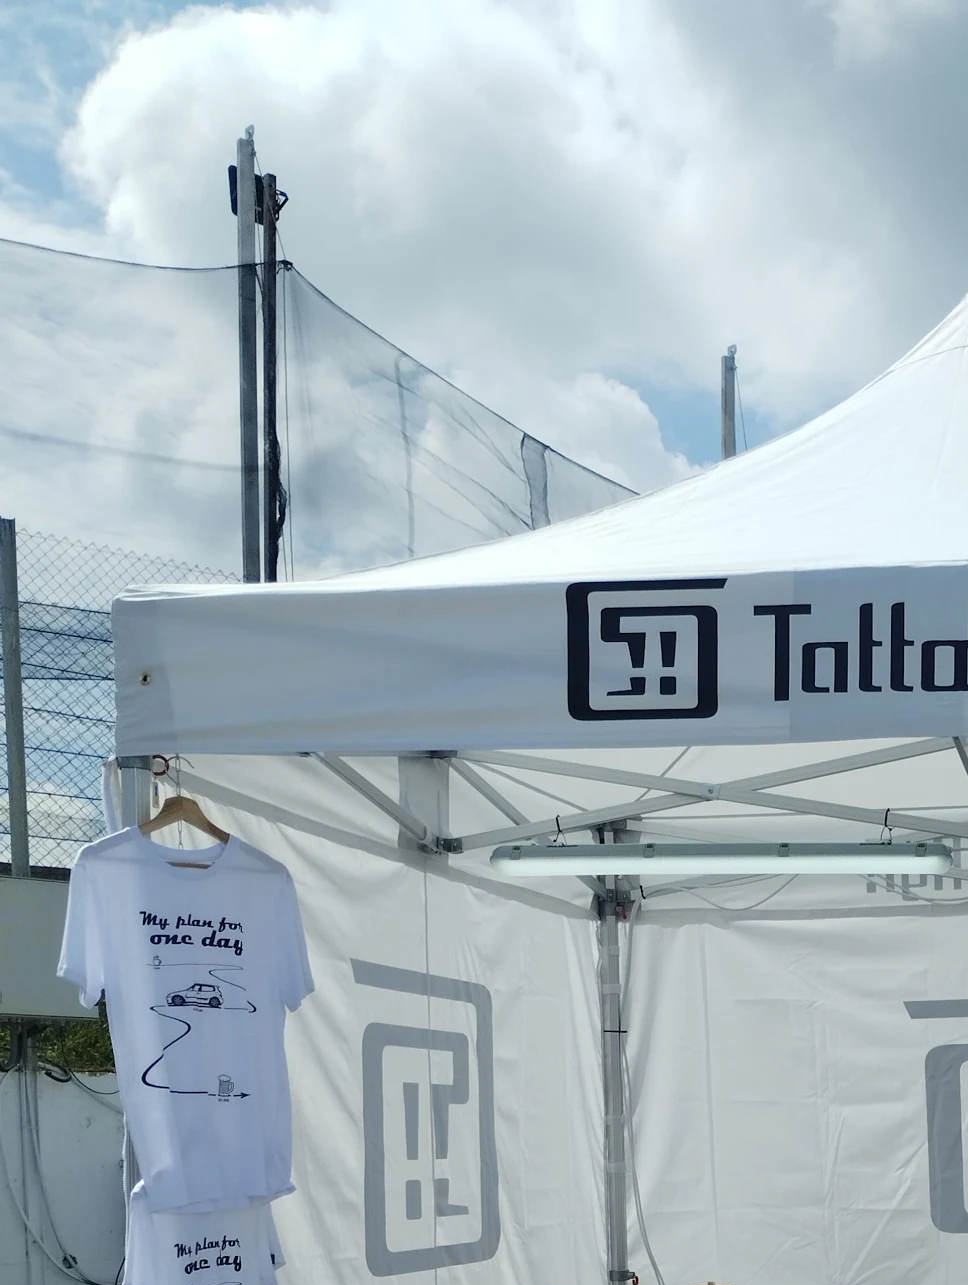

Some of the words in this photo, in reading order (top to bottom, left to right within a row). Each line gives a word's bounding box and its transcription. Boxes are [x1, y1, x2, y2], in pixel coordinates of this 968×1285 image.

[140, 911, 169, 930] My
[176, 914, 214, 929] plan
[218, 917, 243, 933] for
[150, 933, 194, 945] one
[201, 930, 243, 956] day
[195, 1237, 220, 1255] plan
[222, 1235, 241, 1250] for
